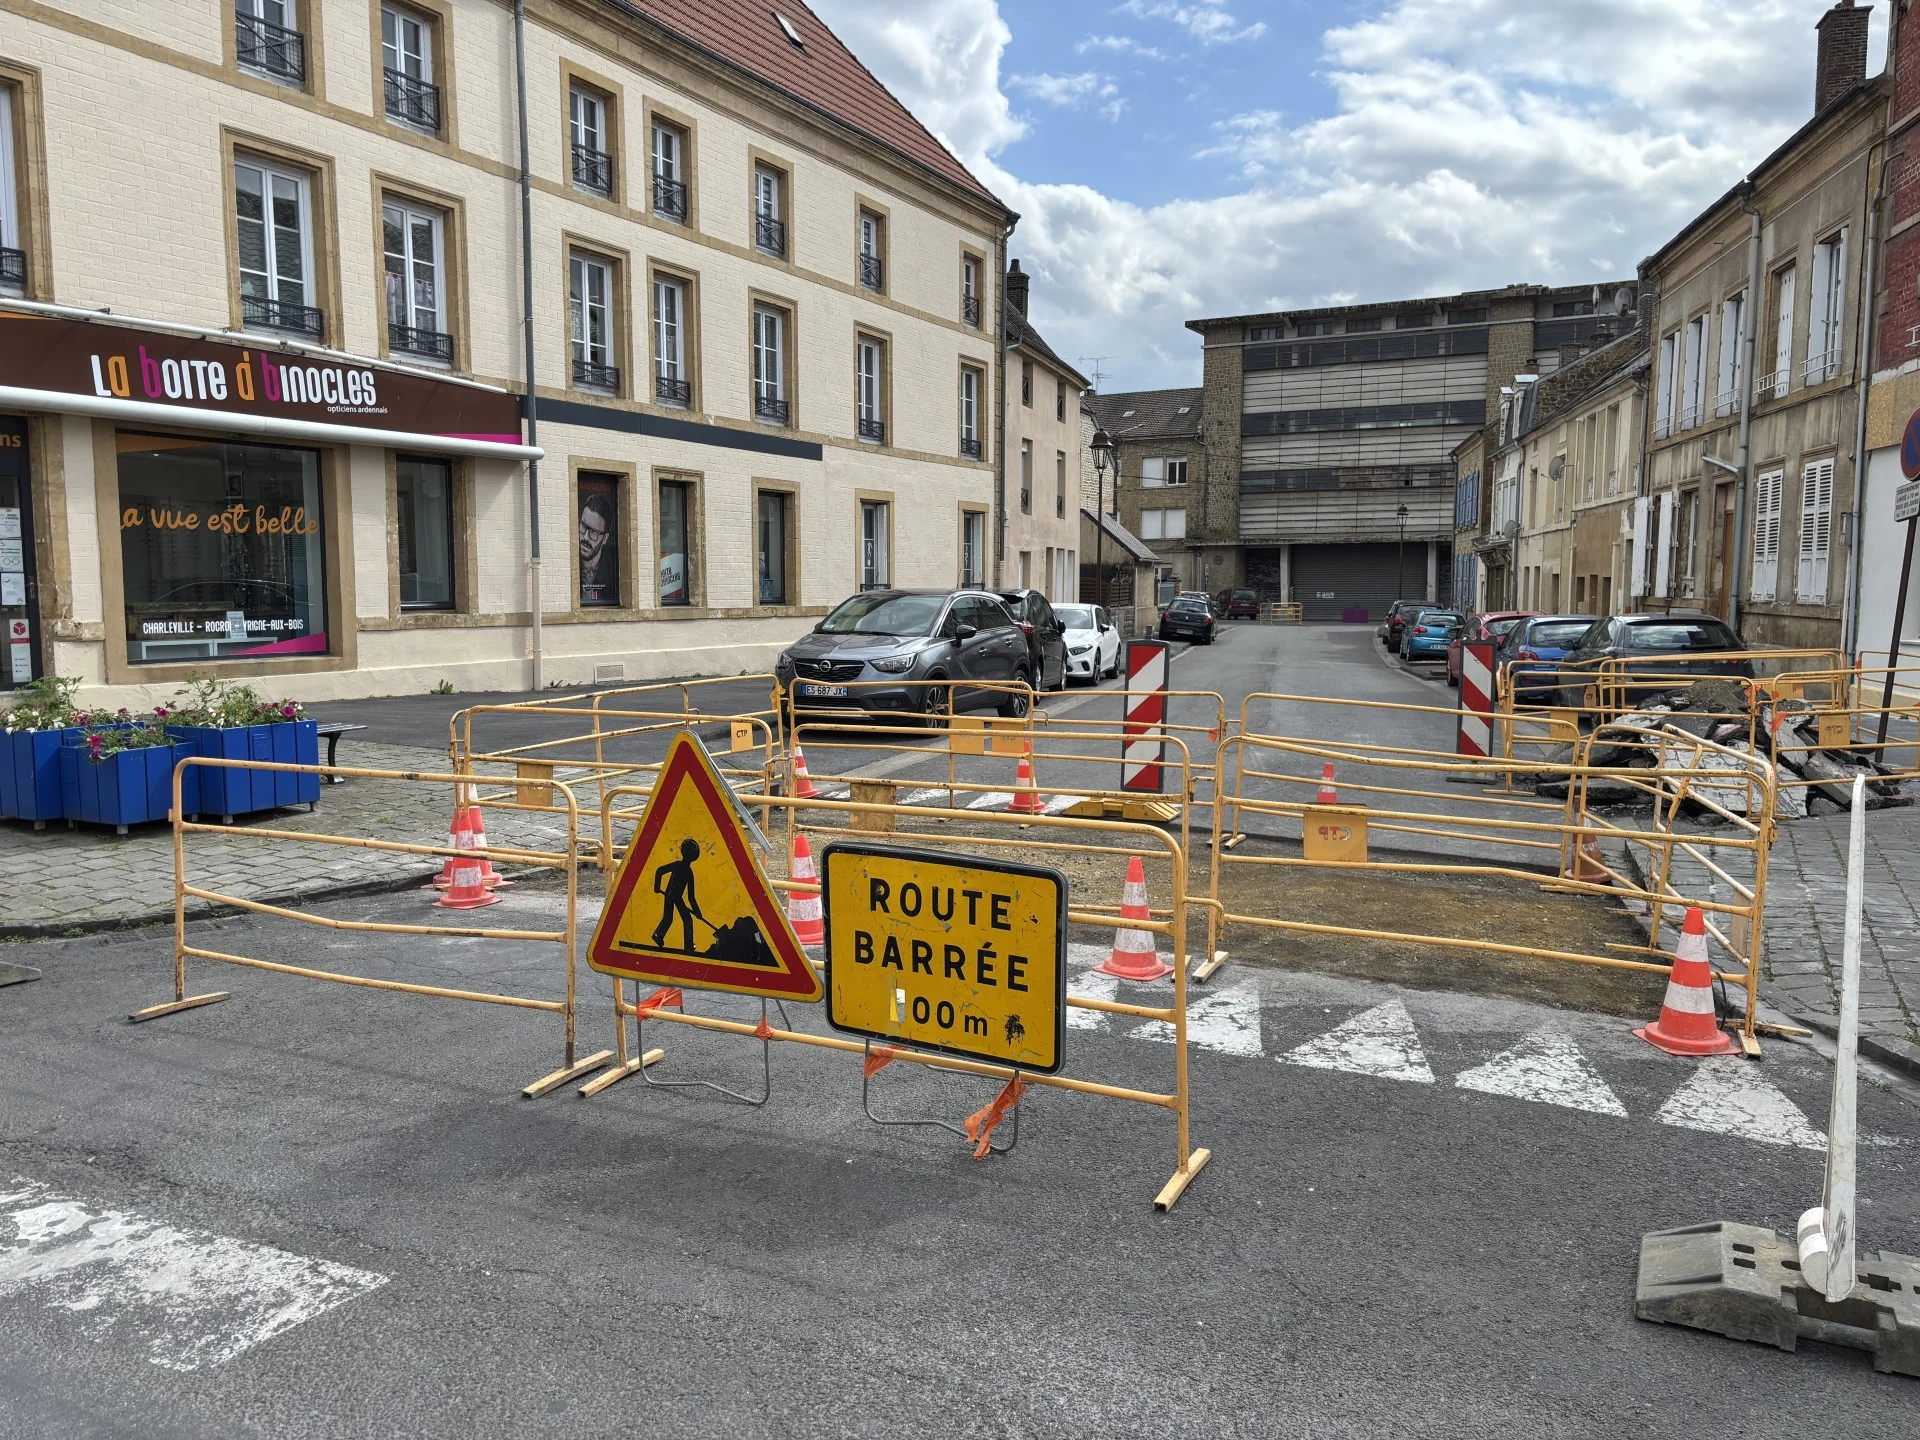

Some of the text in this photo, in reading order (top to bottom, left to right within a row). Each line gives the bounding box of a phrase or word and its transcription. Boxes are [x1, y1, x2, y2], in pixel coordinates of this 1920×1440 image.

[327, 406, 388, 414] opticiens ardennais
[150, 508, 200, 530] vue
[207, 504, 250, 534] est
[256, 504, 320, 535] belle
[142, 622, 194, 634] CHARLEVILLE
[870, 878, 1012, 930] ROUTE
[854, 930, 1028, 992] BARRÉE
